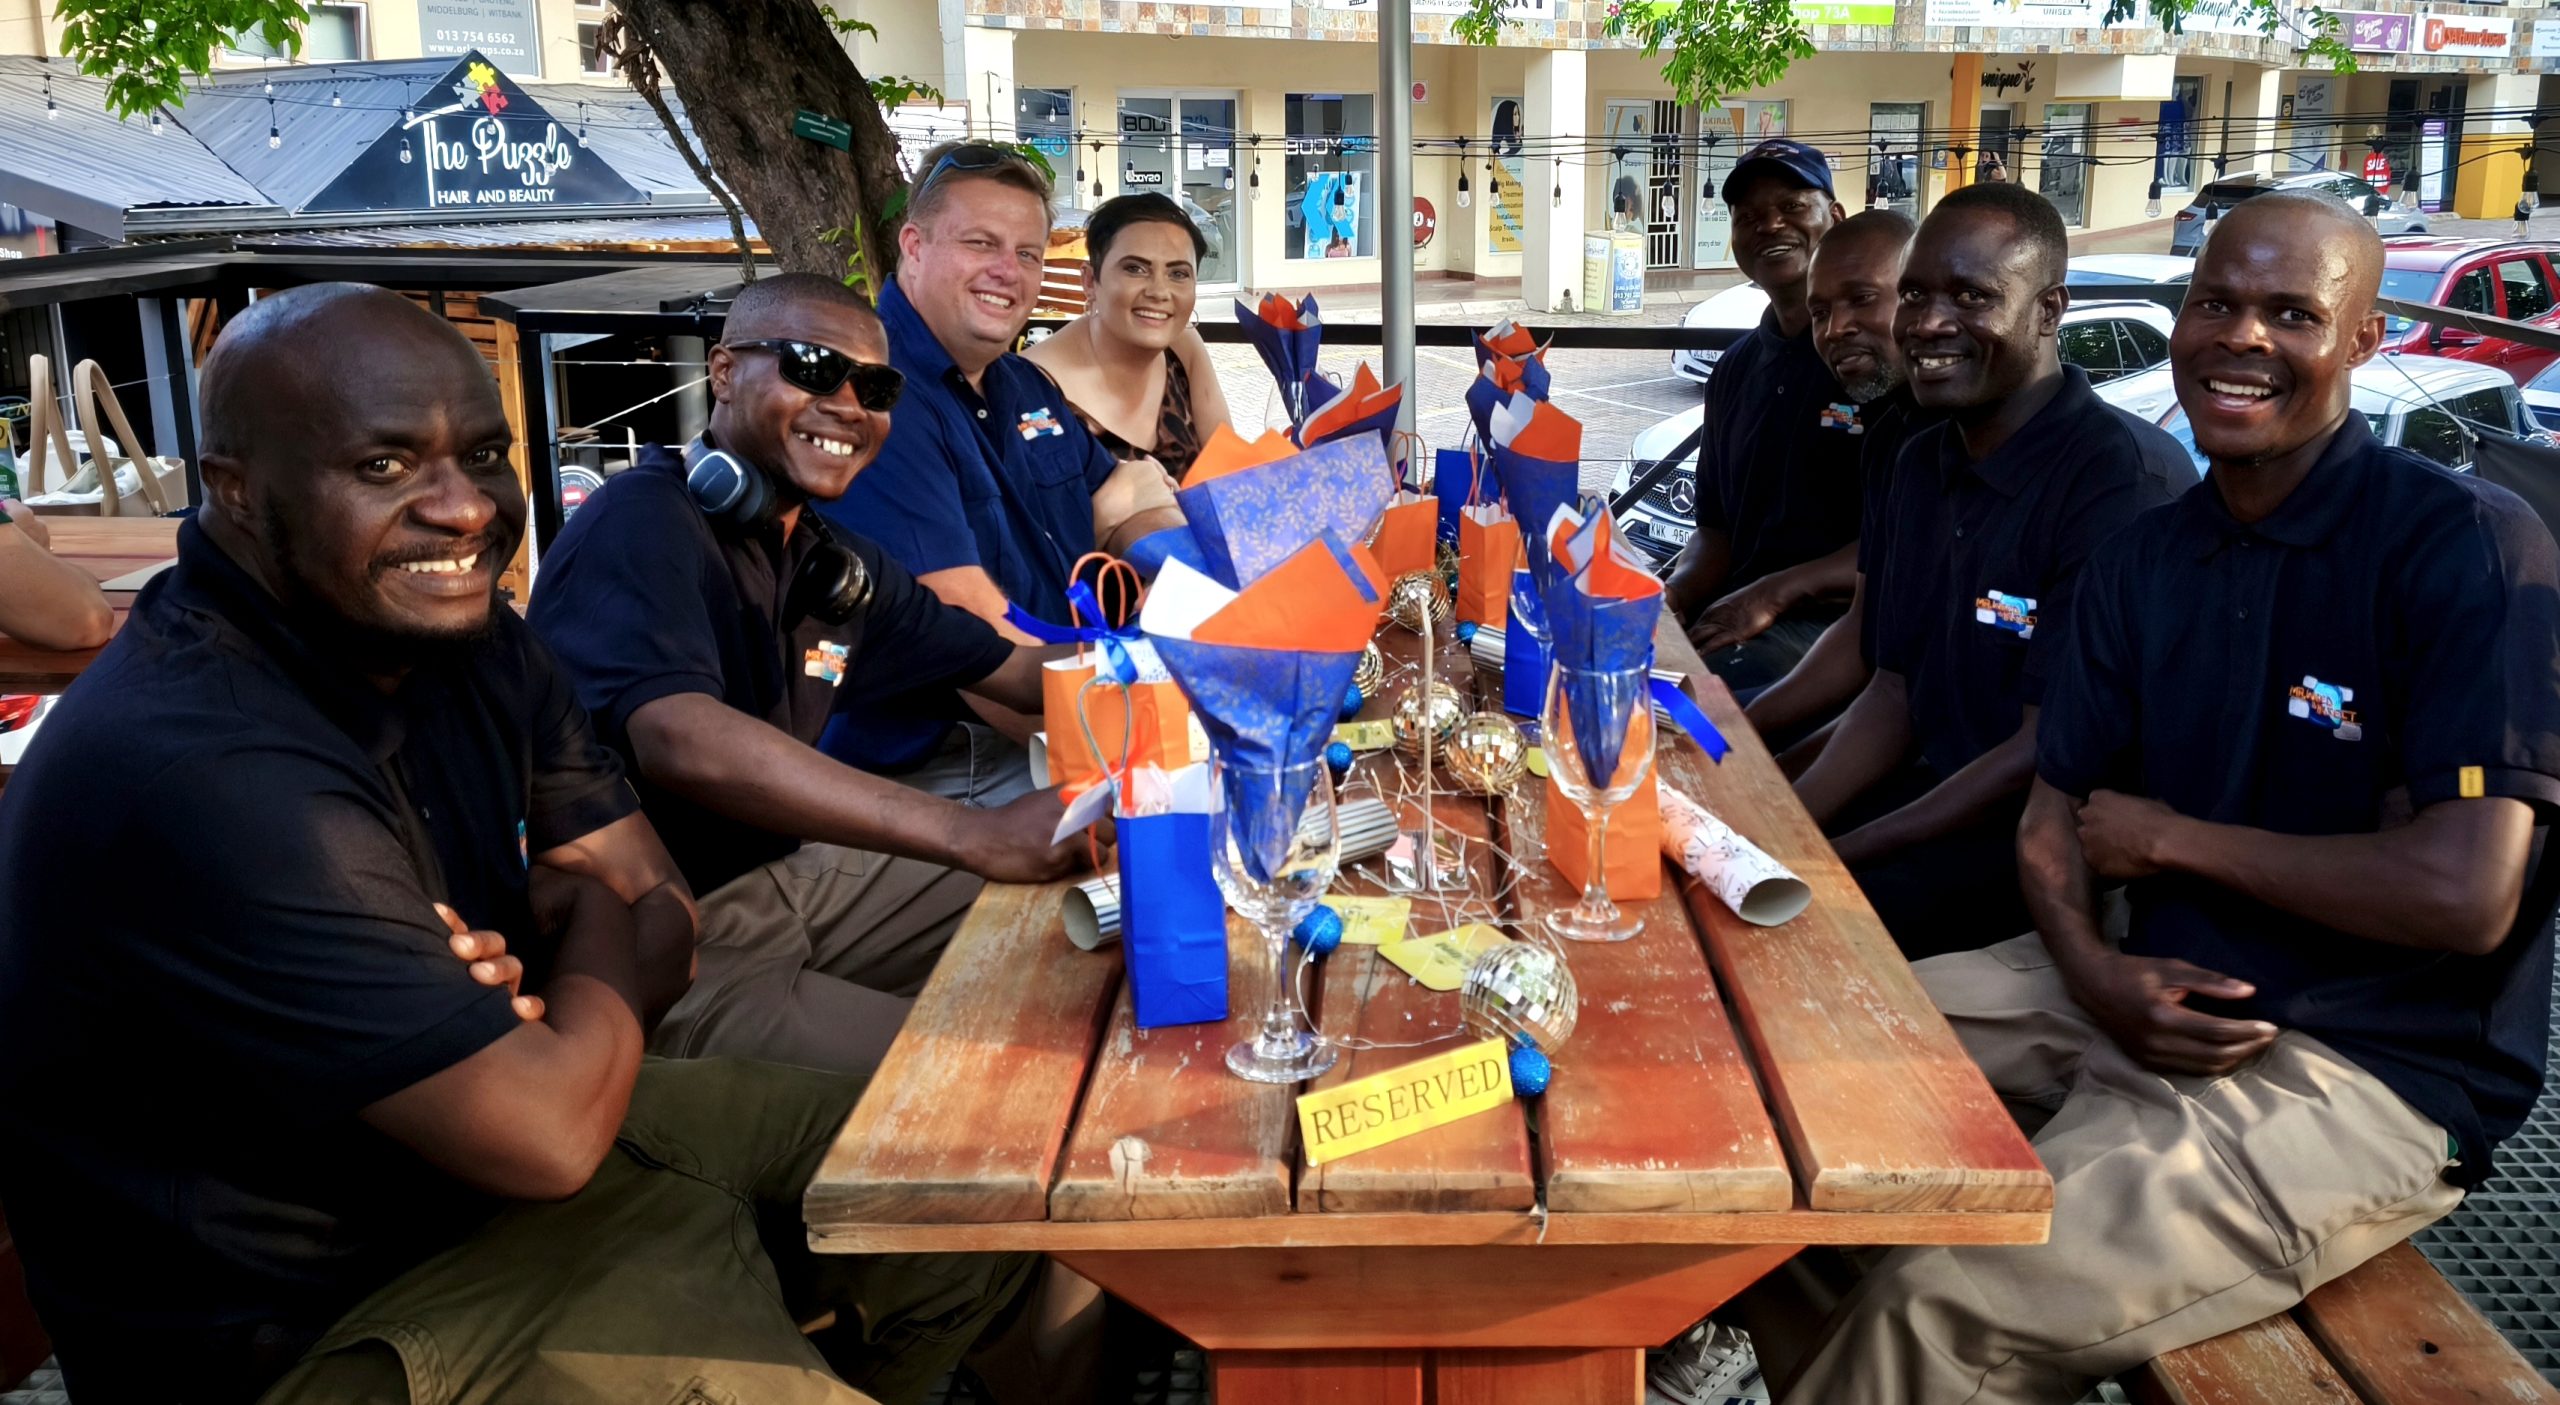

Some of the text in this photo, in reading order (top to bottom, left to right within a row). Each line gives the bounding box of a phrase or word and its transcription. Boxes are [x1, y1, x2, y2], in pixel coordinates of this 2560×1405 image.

[427, 5, 523, 19] MIDDELBURG WITBANK
[1793, 6, 1850, 20] hop 73A
[2043, 8, 2072, 16] UNISEX
[436, 29, 516, 45] 013 754 6562
[428, 43, 525, 57] www.orrops.co.za
[403, 103, 572, 207] The Puzzle
[2366, 158, 2386, 171] SALE
[437, 188, 556, 204] HAIR AND BEAUTY
[0, 247, 23, 259] Shop
[1651, 523, 1690, 543] KWK 950
[1310, 1057, 1502, 1146] RESERVED
